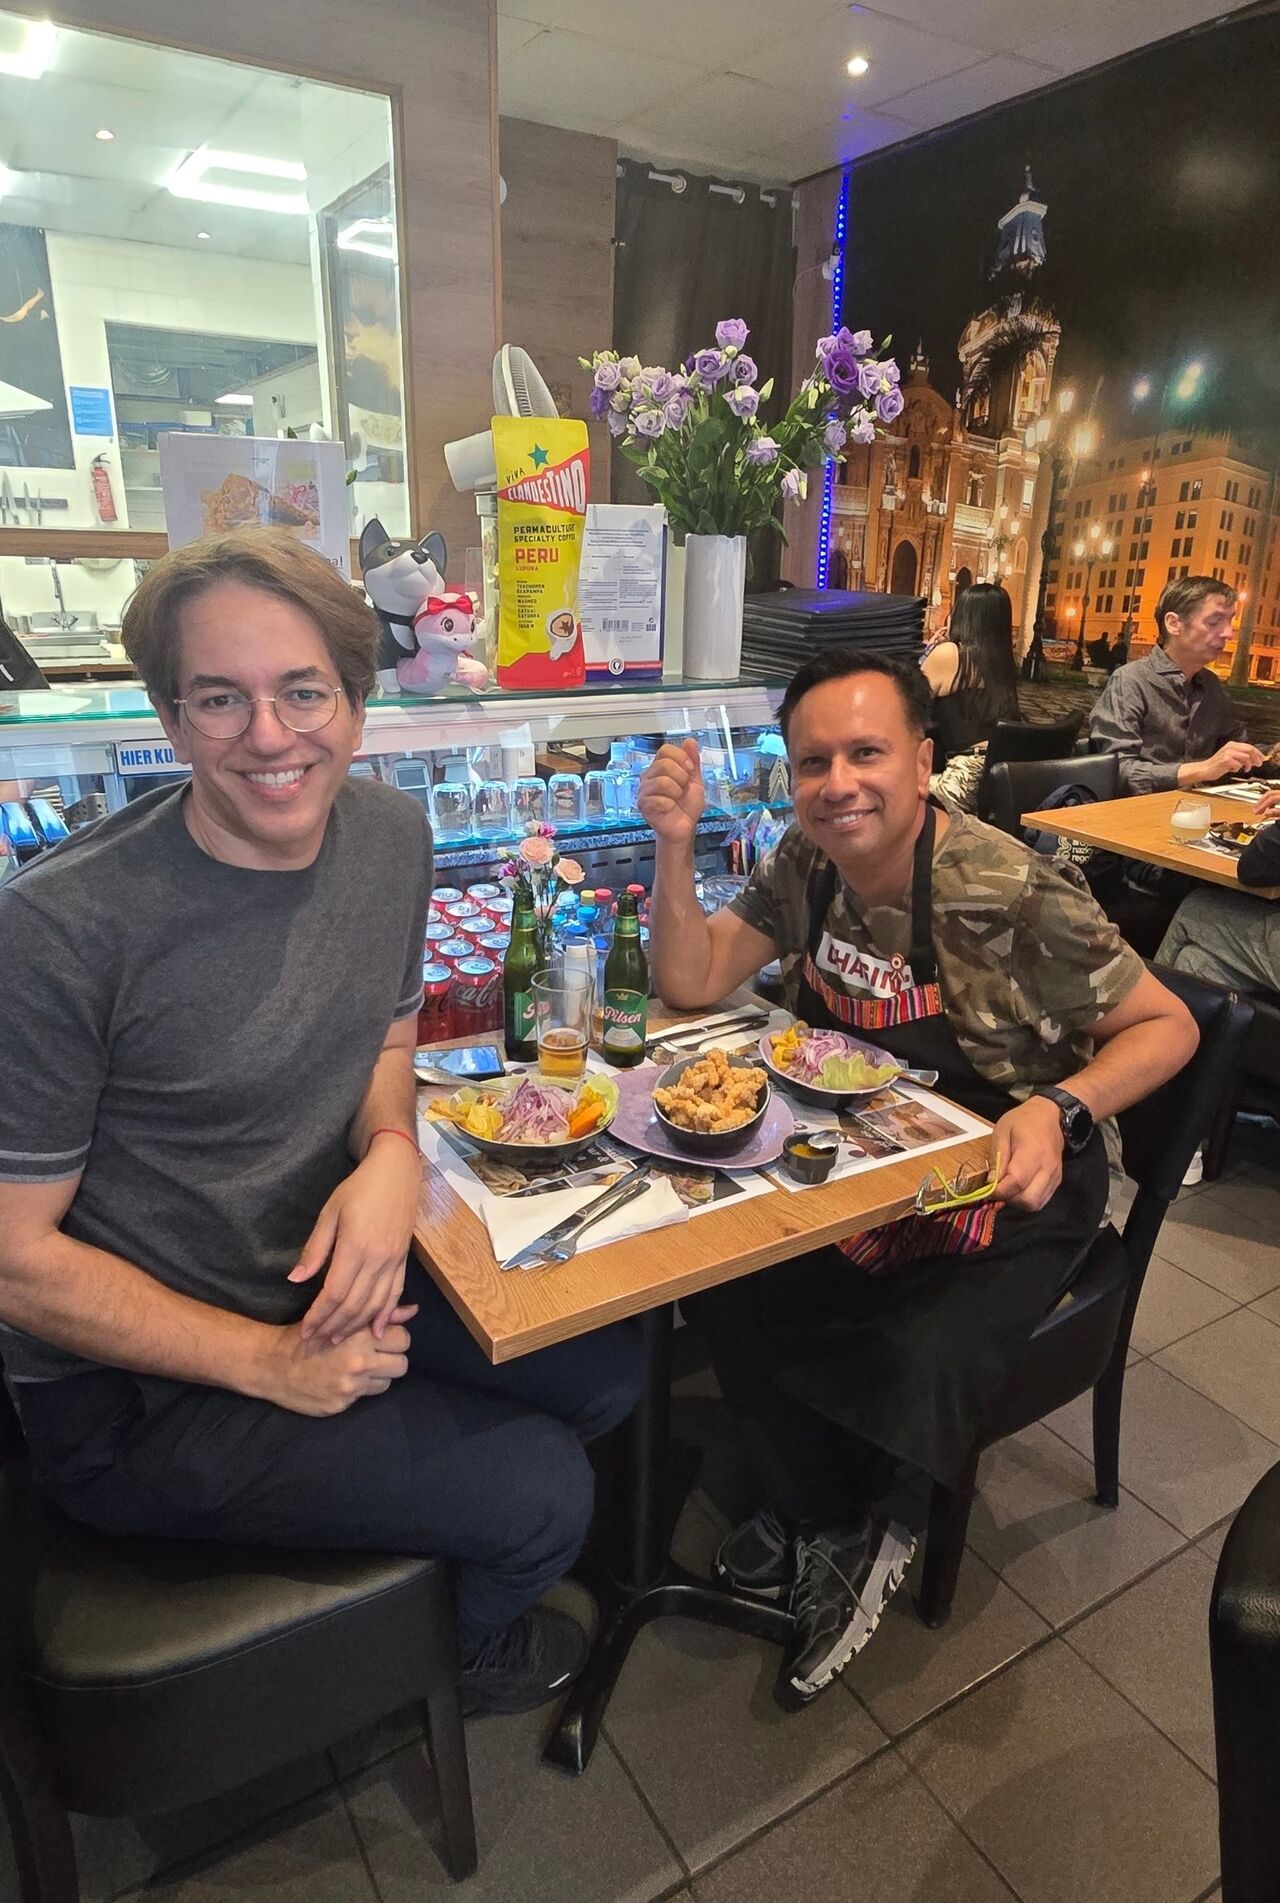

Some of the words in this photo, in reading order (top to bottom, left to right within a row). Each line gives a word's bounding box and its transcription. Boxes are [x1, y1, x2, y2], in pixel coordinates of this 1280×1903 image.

[507, 459, 586, 513] CLANDESTINO
[513, 523, 576, 534] PERMACULTURE
[514, 534, 556, 543] SPECIALTY
[515, 547, 559, 564] PERU
[120, 749, 153, 766] HIER
[604, 1005, 642, 1024] Pilsen
